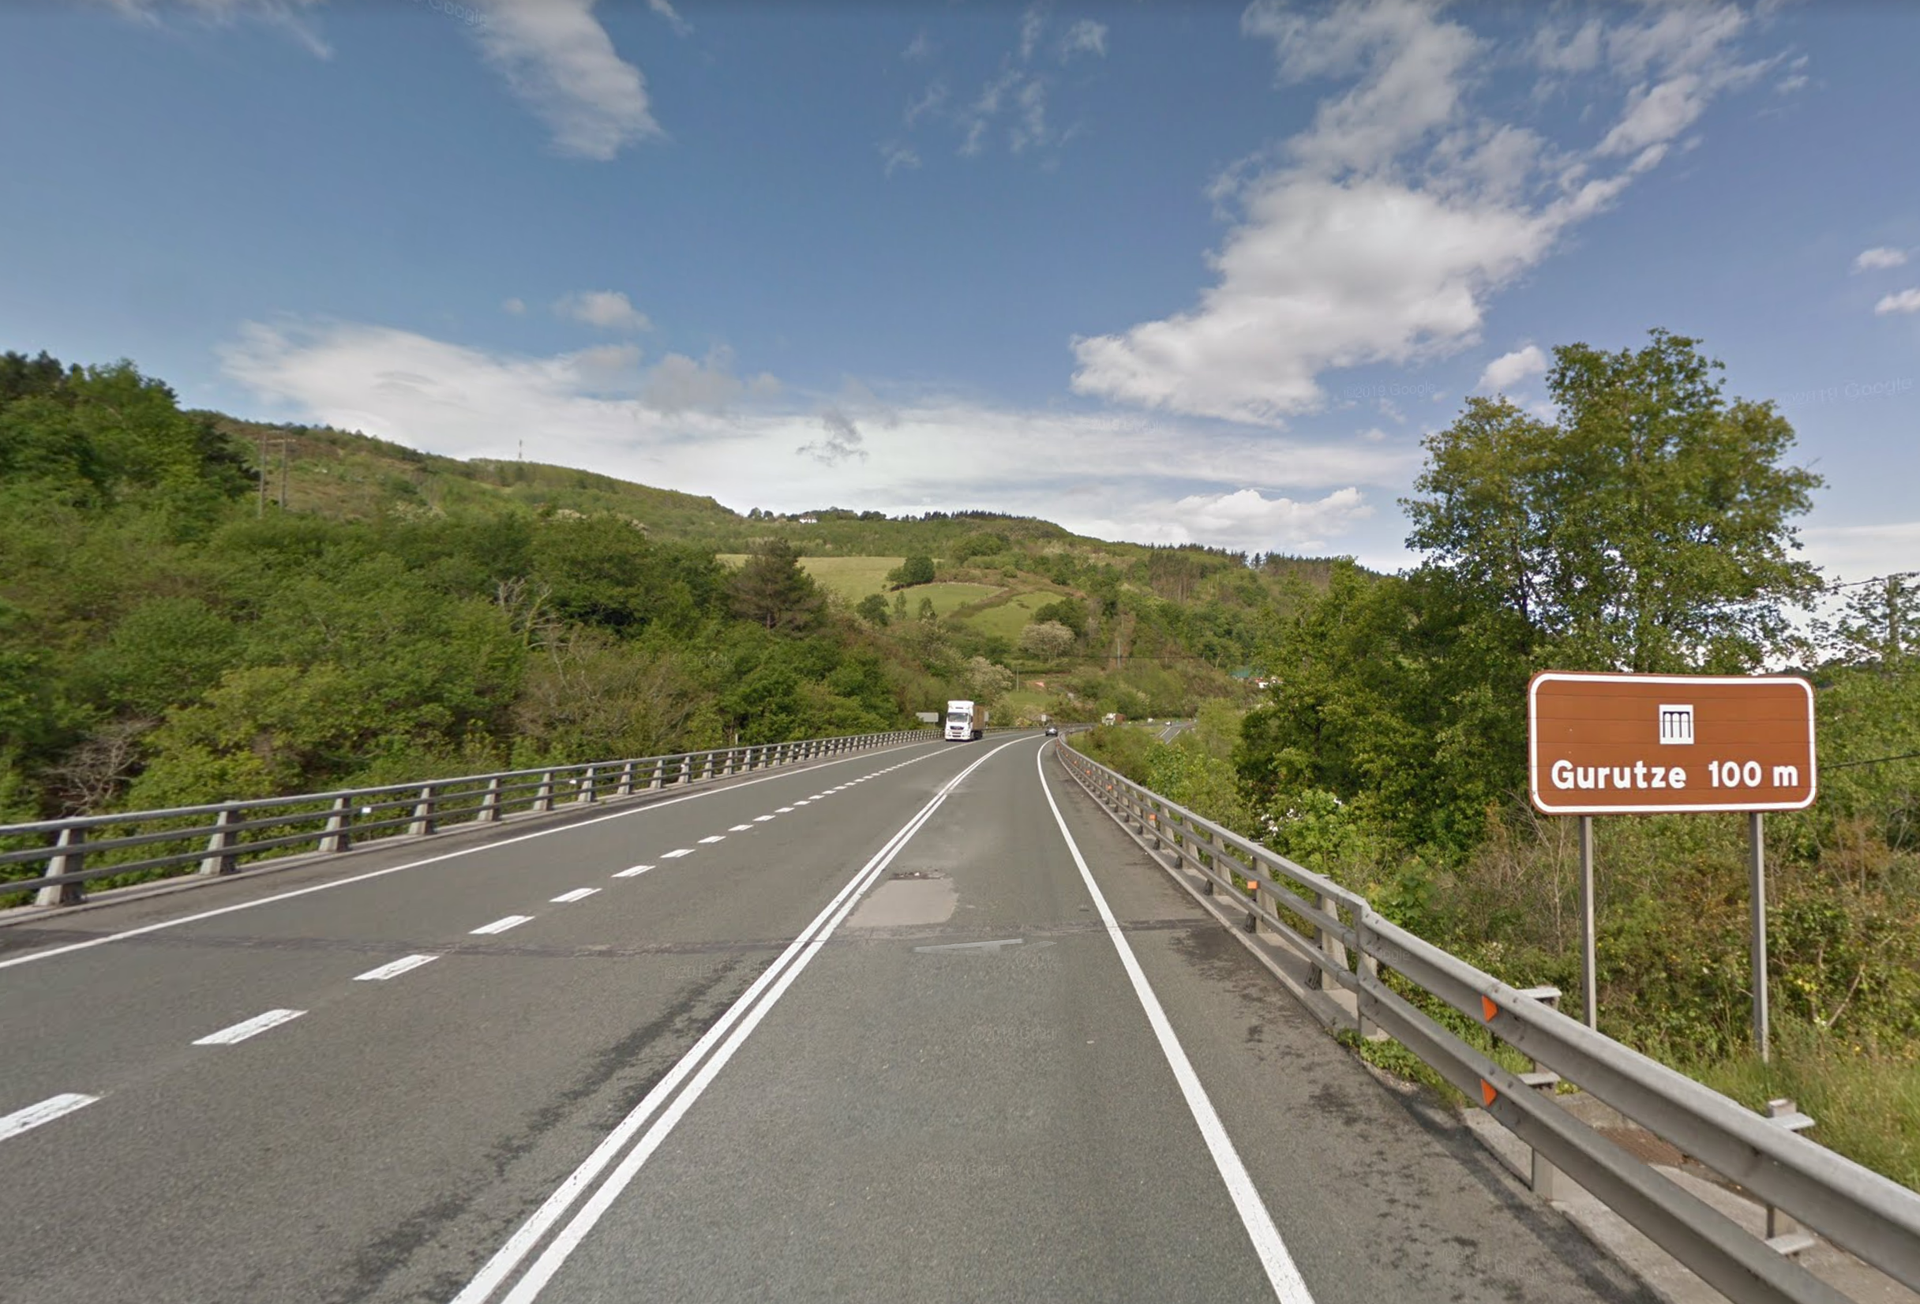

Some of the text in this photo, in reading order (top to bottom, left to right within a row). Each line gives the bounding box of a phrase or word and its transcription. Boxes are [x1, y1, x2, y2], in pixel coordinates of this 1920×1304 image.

[1551, 759, 1799, 790] Gurutze 100 m
